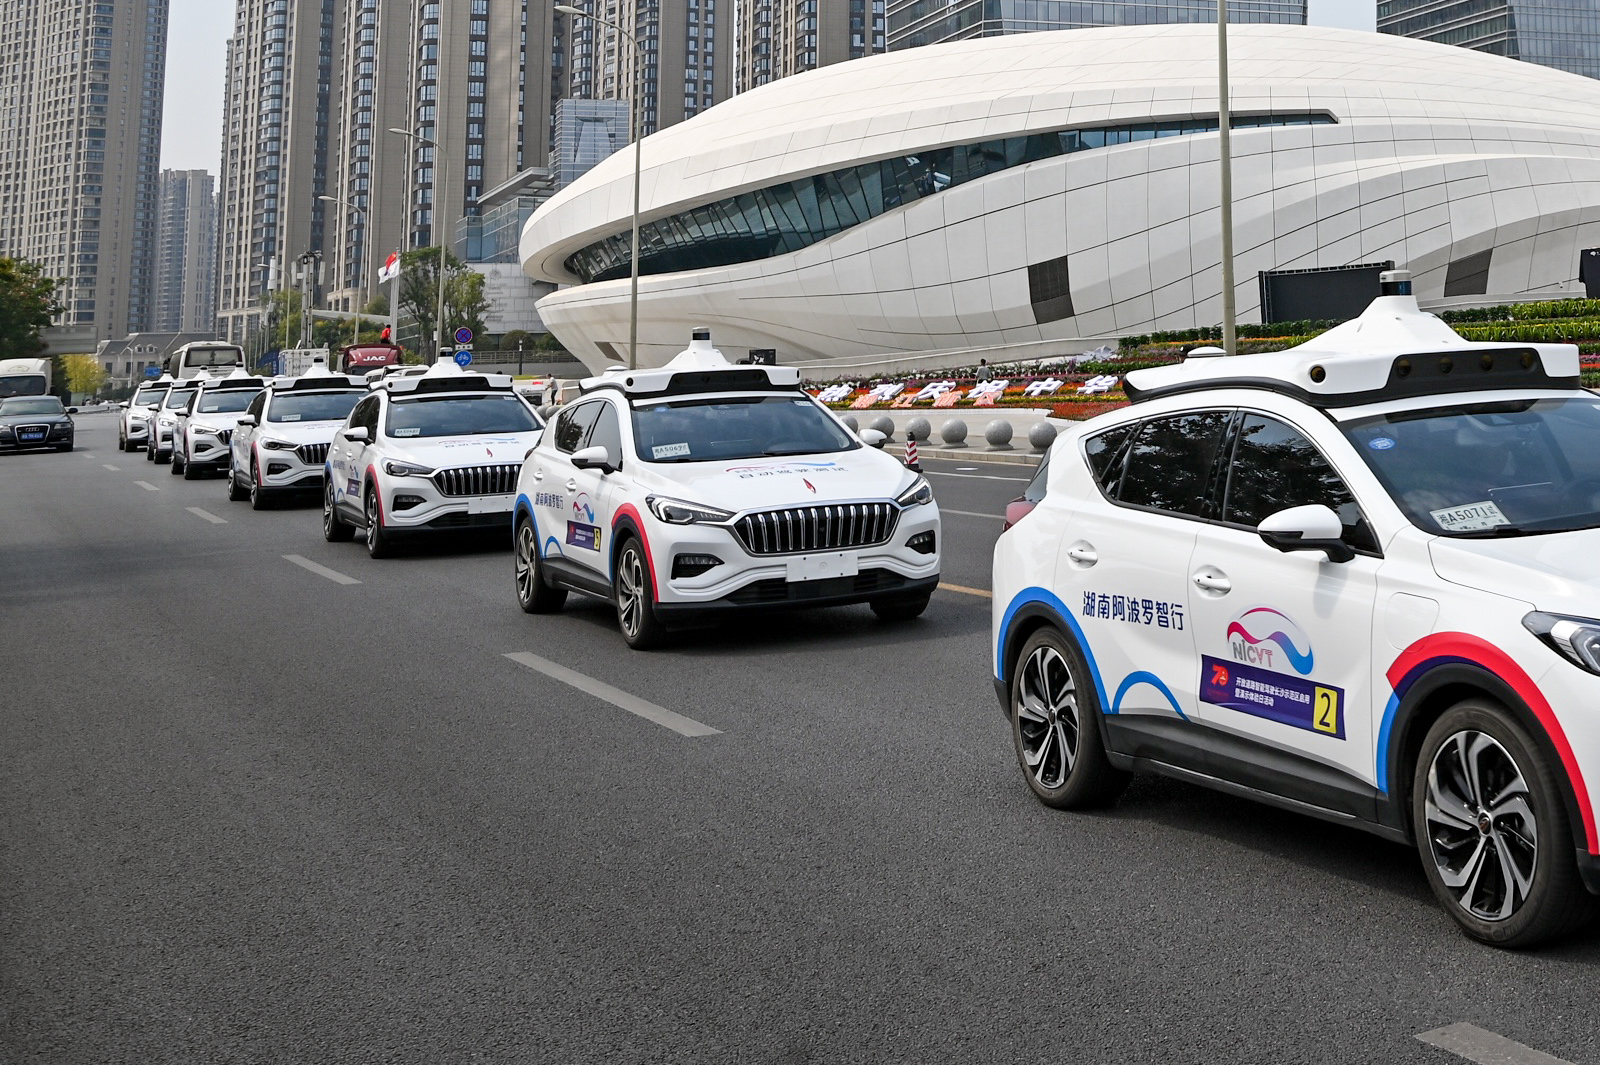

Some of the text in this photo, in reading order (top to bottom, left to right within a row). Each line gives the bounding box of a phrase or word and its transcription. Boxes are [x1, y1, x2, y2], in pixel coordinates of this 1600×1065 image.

[849, 390, 1003, 408] 湘江新区
[1082, 591, 1184, 631] 湖南阿波罗智行
[1232, 639, 1273, 668] NICVT
[1235, 677, 1310, 704] 开放道路智能驾驶长沙示范区启用
[1319, 692, 1331, 728] 2
